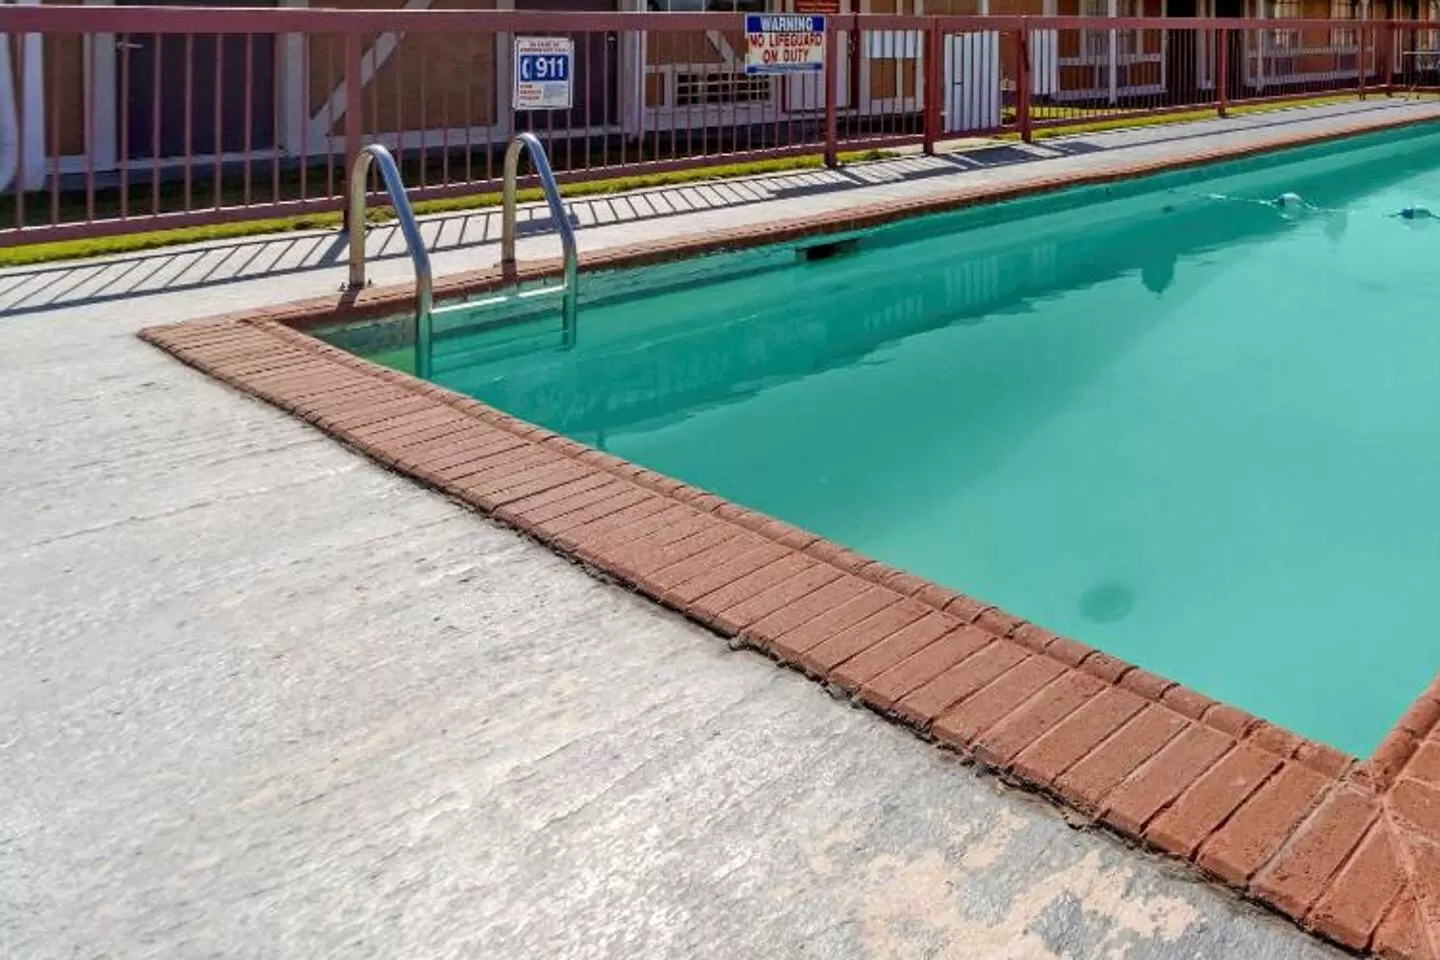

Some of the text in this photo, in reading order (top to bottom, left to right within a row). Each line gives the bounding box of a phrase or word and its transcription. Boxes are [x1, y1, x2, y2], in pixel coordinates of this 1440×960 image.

[760, 16, 814, 32] WARNING
[750, 33, 822, 47] NO LIFEGUARD
[763, 48, 809, 64] ON DUTY
[535, 57, 564, 78] 911
